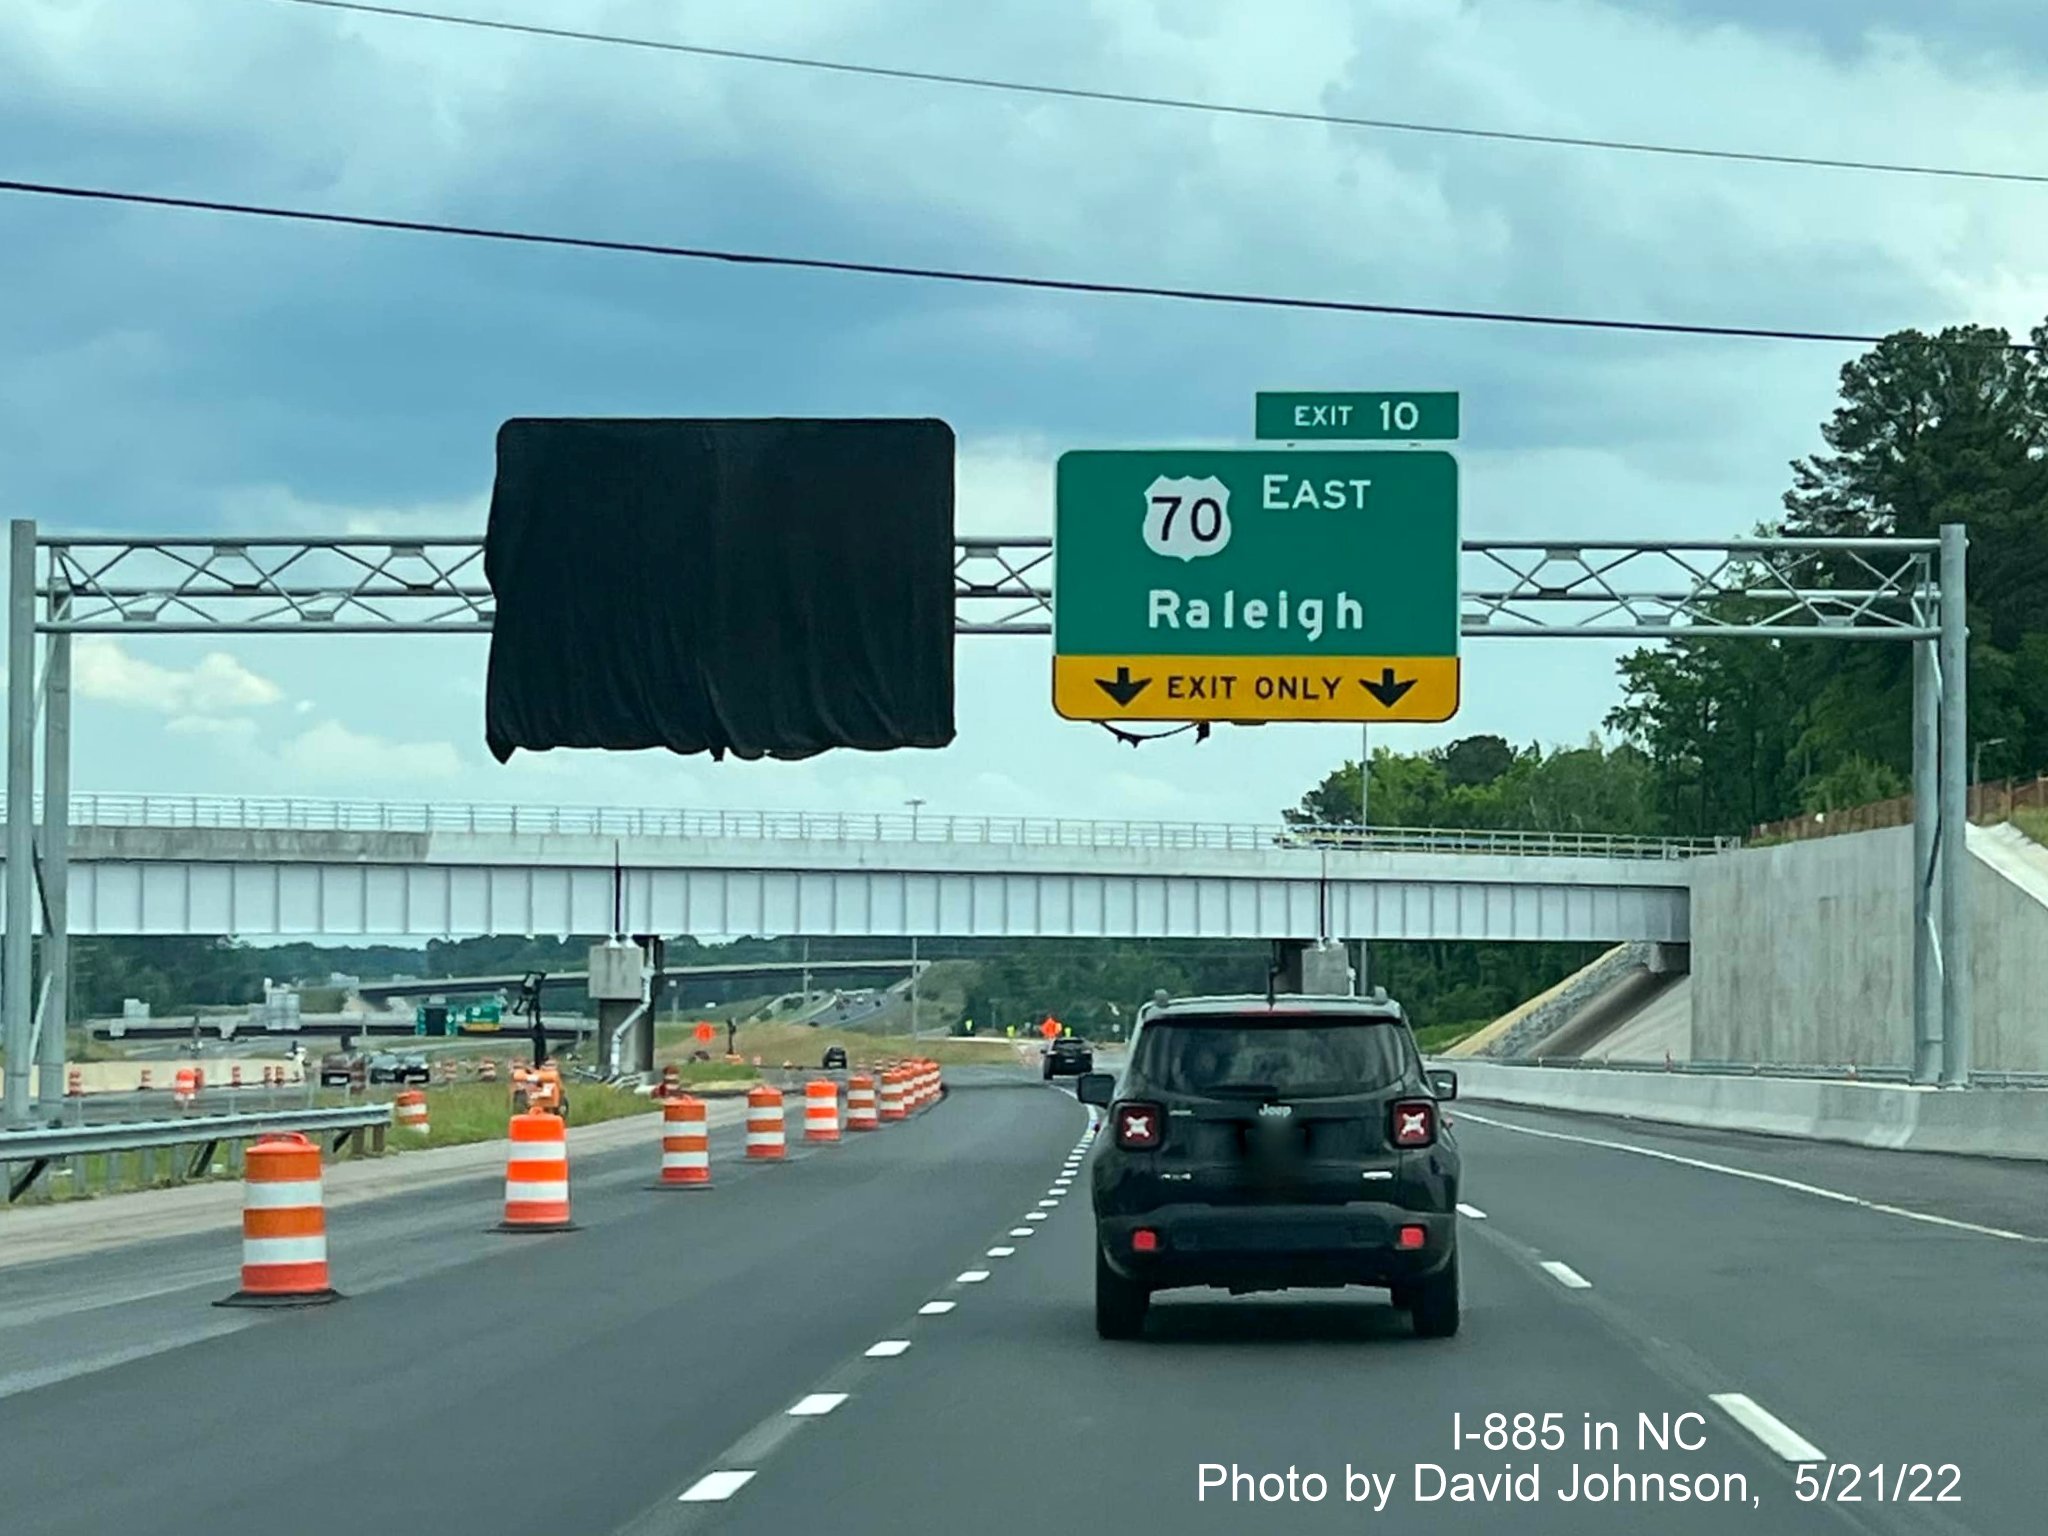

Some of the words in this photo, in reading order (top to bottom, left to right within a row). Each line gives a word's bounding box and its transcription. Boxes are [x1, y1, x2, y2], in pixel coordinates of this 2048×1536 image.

[1294, 405, 1353, 426] EXIT
[1379, 401, 1419, 431] 10
[1263, 474, 1371, 510] EAST
[1151, 496, 1222, 542] 70
[1148, 589, 1364, 642] Raleigh
[1167, 676, 1238, 699] EXIT
[1255, 676, 1342, 700] ONLY
[1258, 1103, 1293, 1118] Jeep
